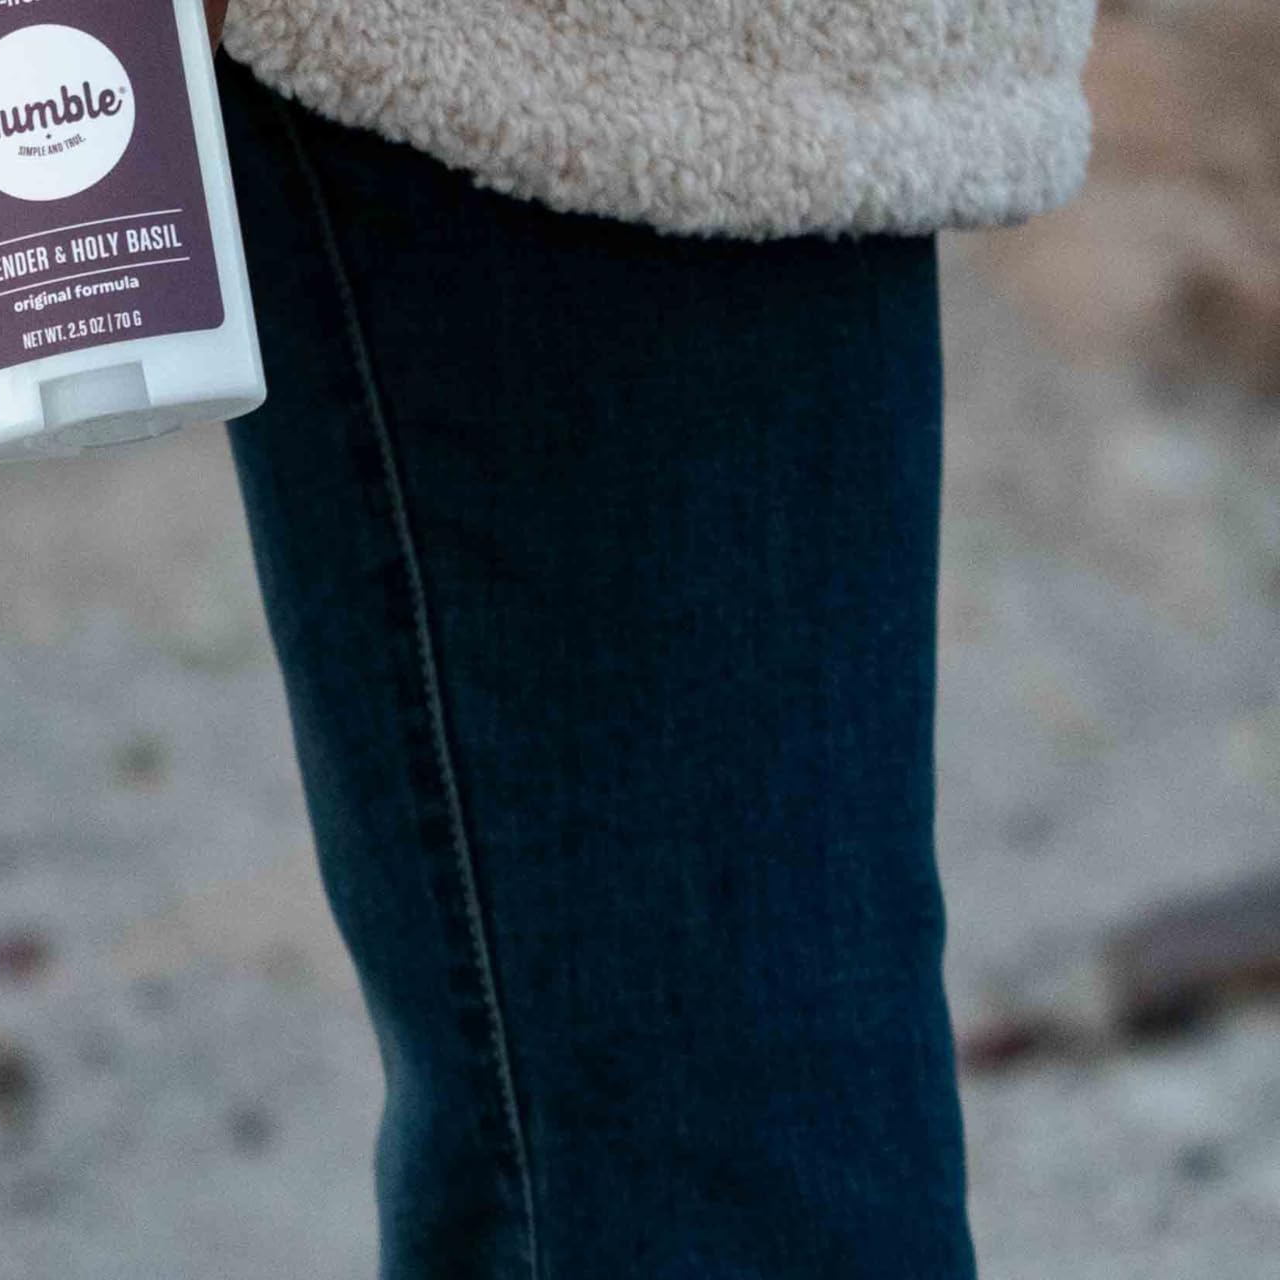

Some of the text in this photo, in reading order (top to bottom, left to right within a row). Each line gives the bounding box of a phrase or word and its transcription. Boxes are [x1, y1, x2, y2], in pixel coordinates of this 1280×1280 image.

[18, 145, 46, 157] SIMPLE
[48, 144, 64, 154] AND
[55, 246, 67, 264] &
[70, 232, 118, 263] HOLY
[126, 224, 182, 253] BASIL
[14, 275, 140, 313] original formula
[23, 331, 43, 350] NET
[44, 325, 67, 344] WT.
[67, 321, 87, 339] 2.5
[89, 317, 105, 335] OZ
[114, 312, 132, 330] 70
[133, 310, 142, 327] G
